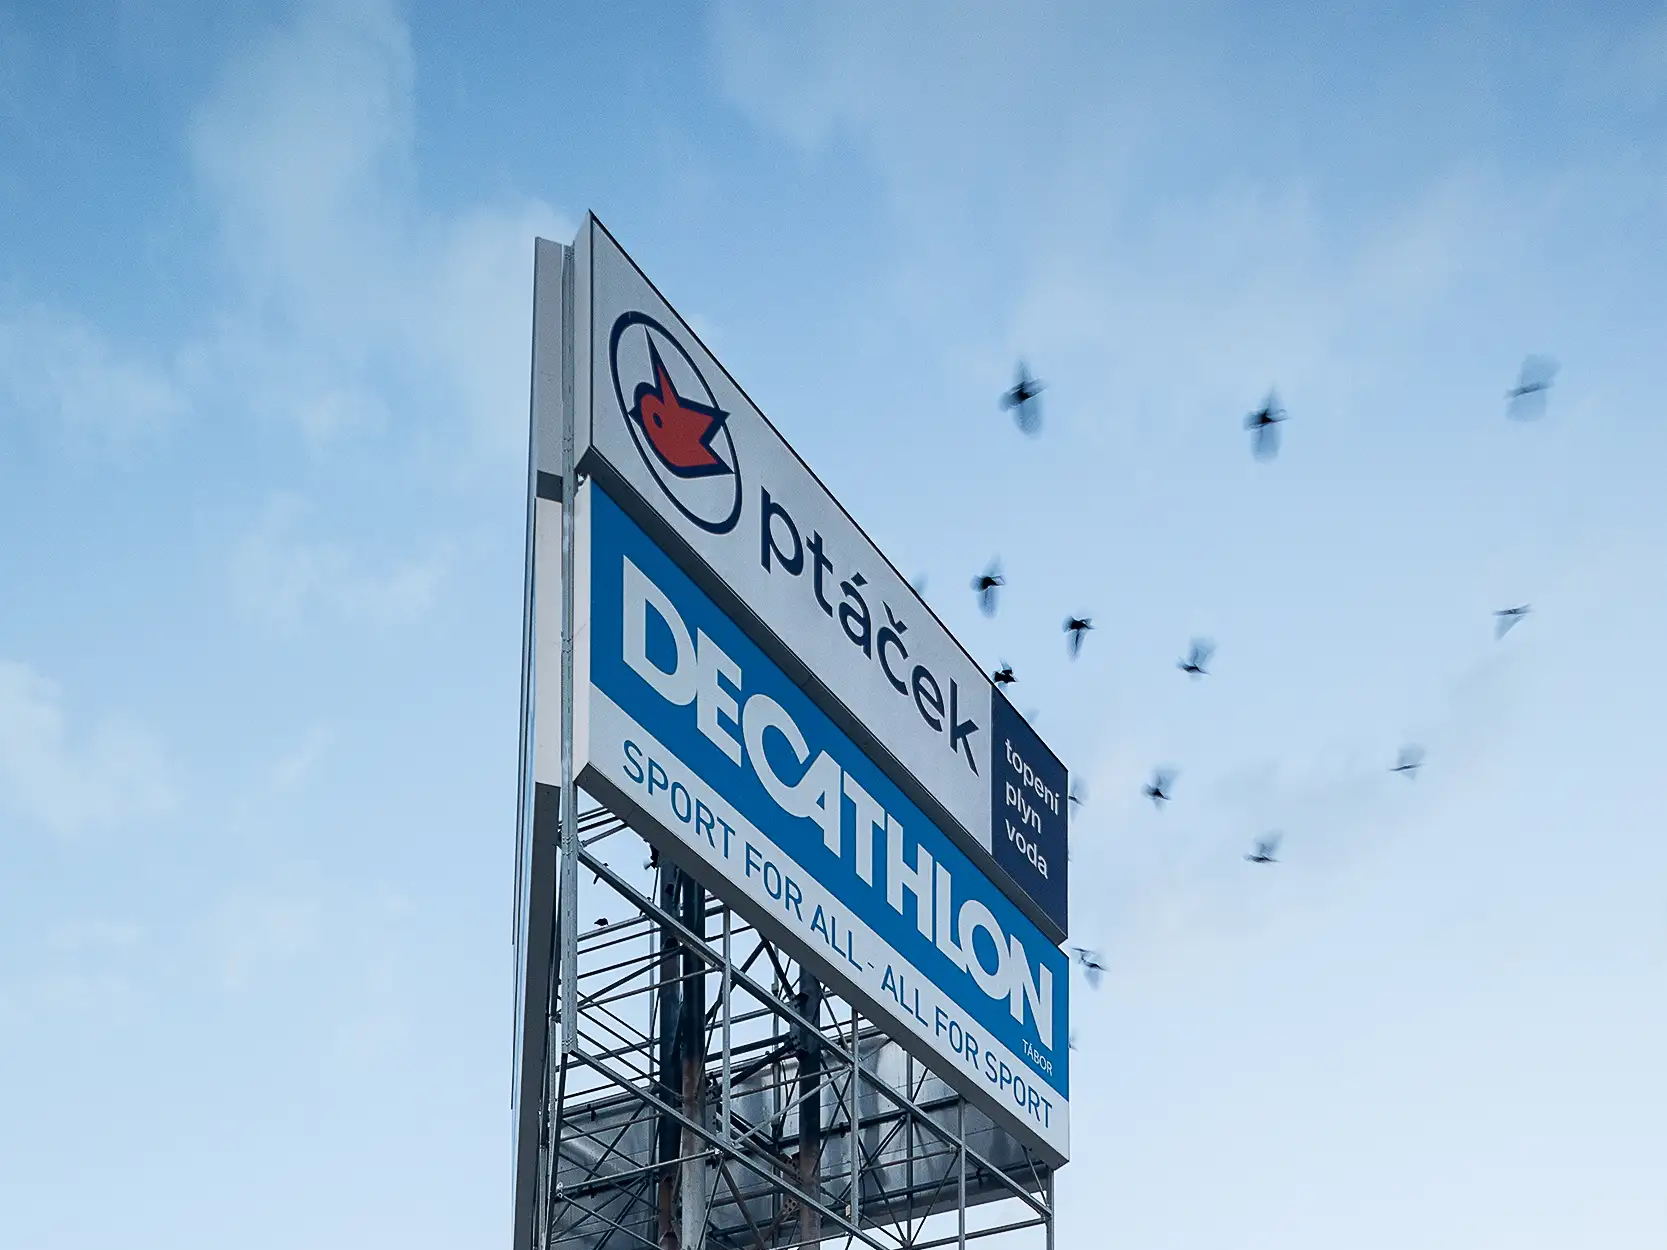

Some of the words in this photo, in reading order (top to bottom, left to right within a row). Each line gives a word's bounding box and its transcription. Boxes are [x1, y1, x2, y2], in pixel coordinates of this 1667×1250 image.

[761, 486, 979, 778] ptáček
[621, 554, 1054, 1051] DECATHLON
[1004, 737, 1060, 817] topení
[1004, 787, 1043, 836] plyn
[1004, 824, 1049, 881] voda
[623, 739, 736, 860] SPORT
[745, 841, 803, 921] FOR
[809, 912, 863, 973] ALL
[880, 964, 928, 1029] ALL
[934, 1006, 980, 1072] FOR
[984, 1052, 1053, 1130] SPORT
[1021, 1037, 1054, 1078] TÁBOR
